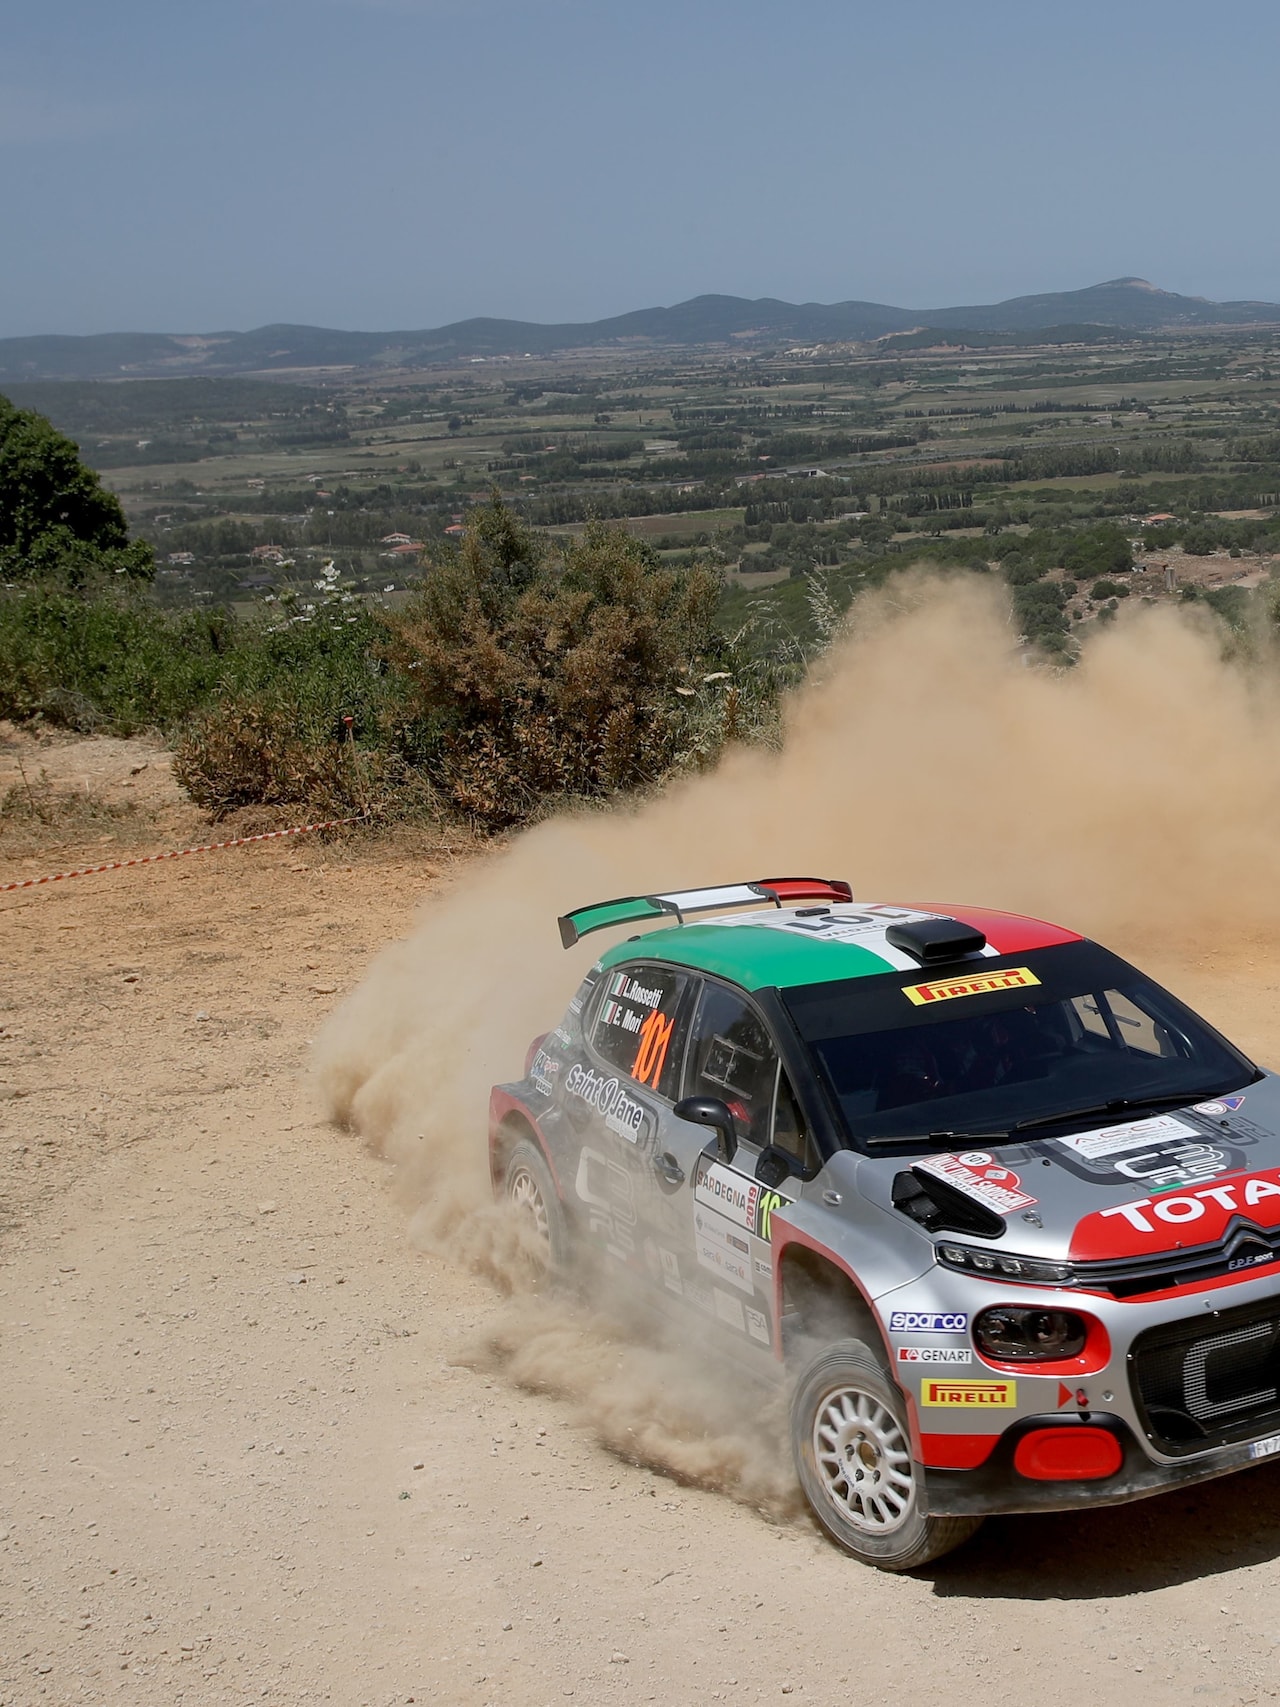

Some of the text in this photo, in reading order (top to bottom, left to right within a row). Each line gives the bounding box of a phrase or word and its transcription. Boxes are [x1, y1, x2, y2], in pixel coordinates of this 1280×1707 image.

[915, 970, 1027, 1001] PIRELLI
[621, 1009, 644, 1034] Mori
[631, 1009, 675, 1090] 101
[566, 1063, 604, 1106] Saint
[608, 1090, 643, 1130] Jane
[966, 1154, 987, 1164] 101
[1114, 1143, 1225, 1178] C3
[696, 1171, 746, 1211] SARDEGNA
[746, 1186, 757, 1229] 2019
[760, 1190, 791, 1242] 10
[891, 1313, 967, 1332] sparco
[921, 1349, 972, 1362] GENART
[928, 1383, 1008, 1403] PIRELLI
